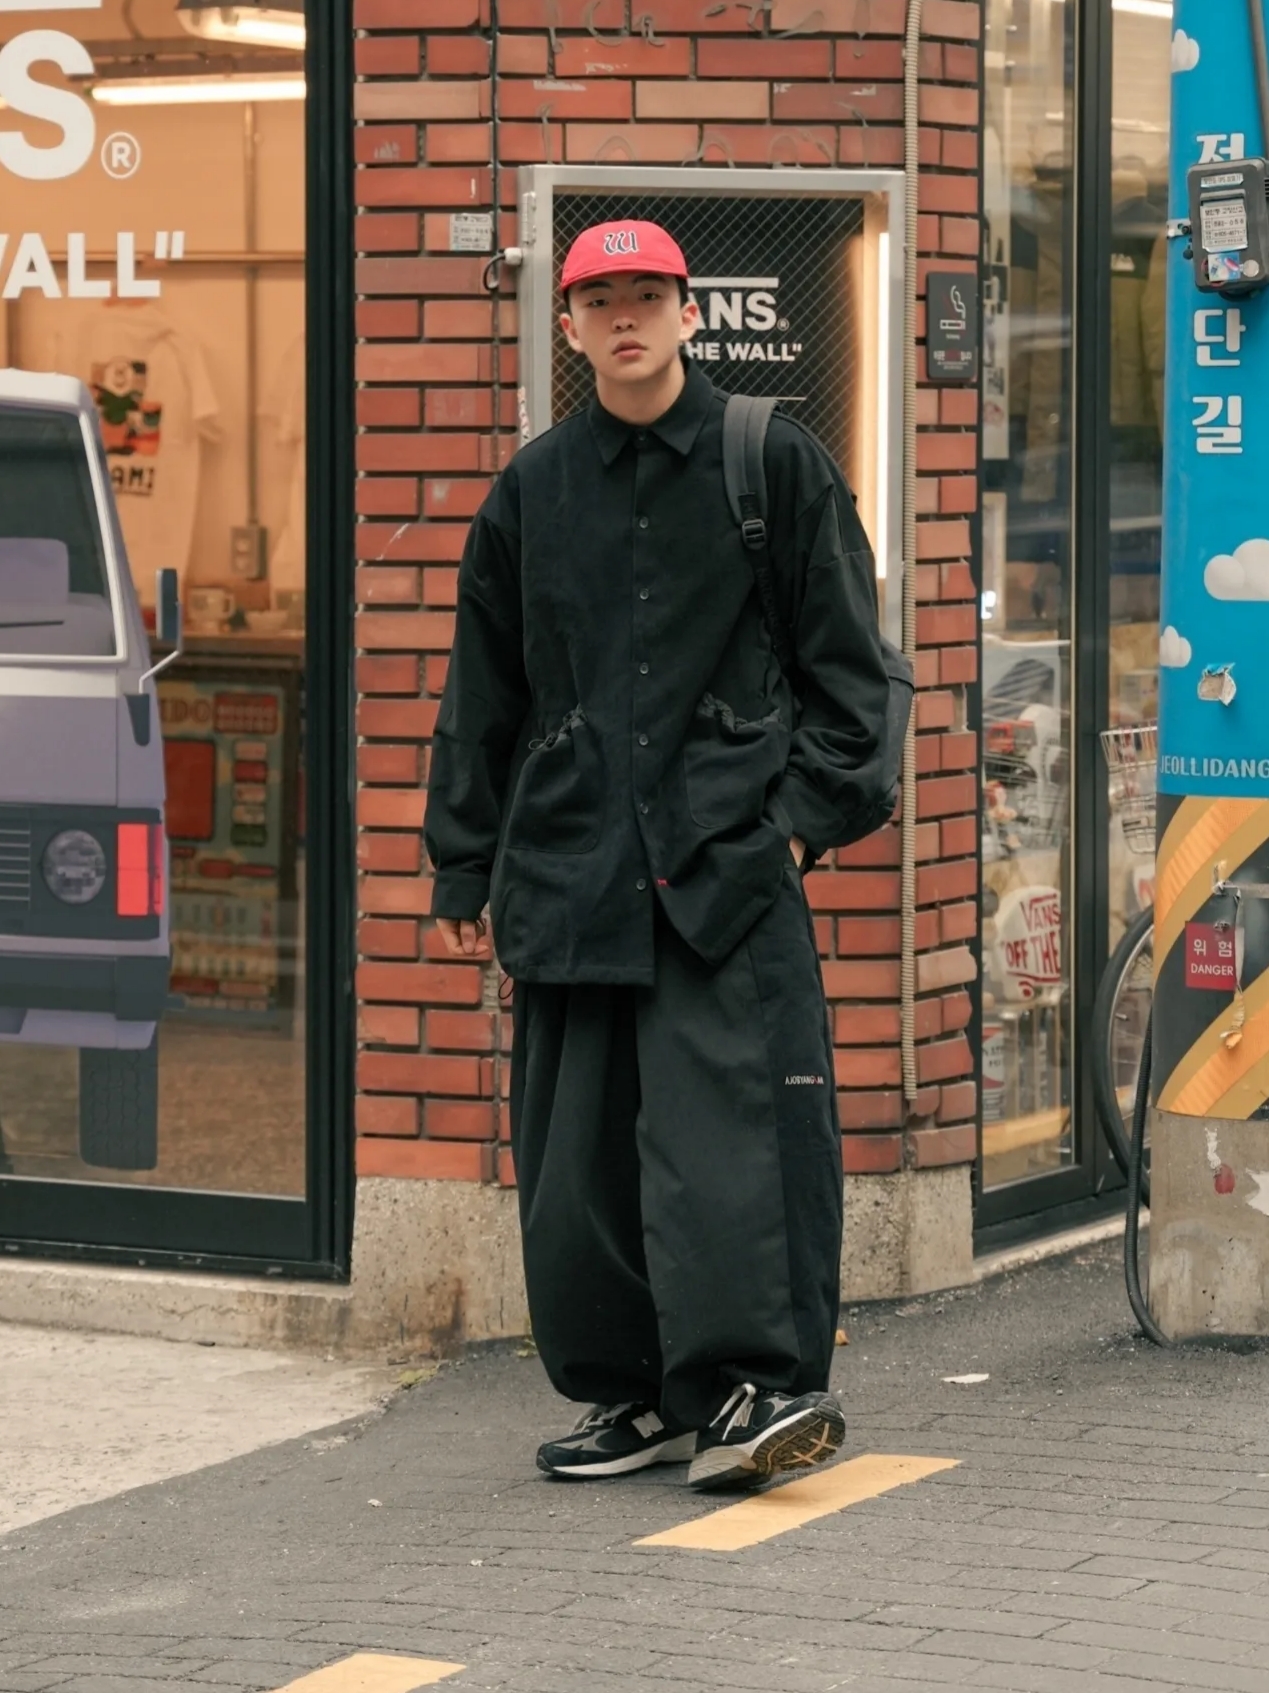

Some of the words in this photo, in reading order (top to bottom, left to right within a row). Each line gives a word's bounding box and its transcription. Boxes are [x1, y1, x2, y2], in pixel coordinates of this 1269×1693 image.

[0, 231, 185, 299] ALL"
[725, 342, 802, 361] WALL"
[1190, 963, 1234, 976] DANGER
